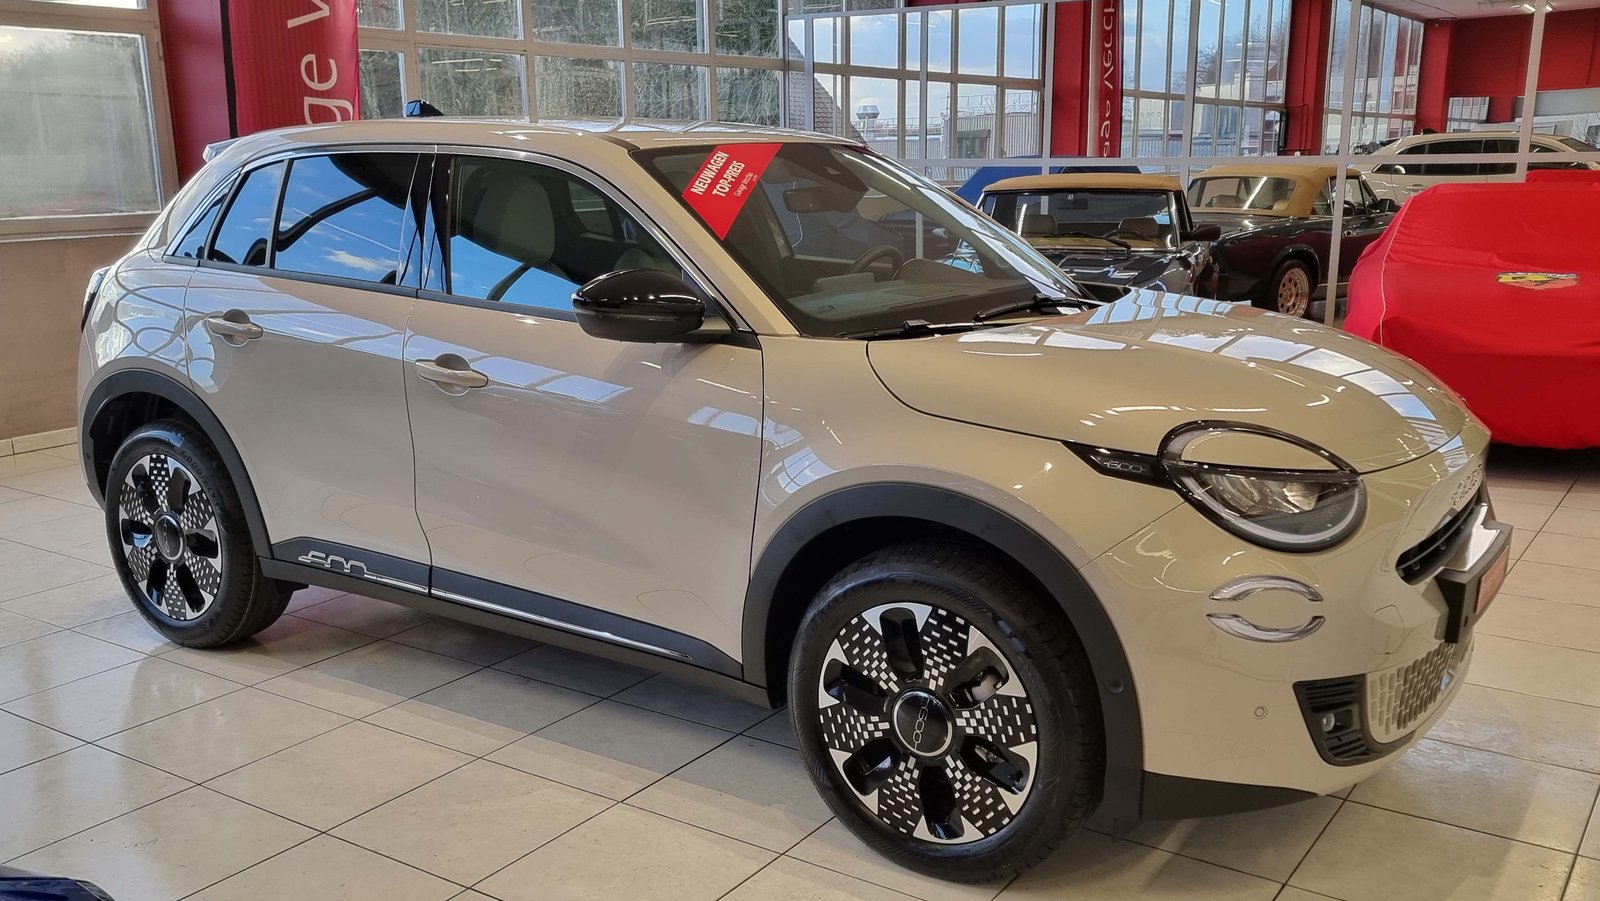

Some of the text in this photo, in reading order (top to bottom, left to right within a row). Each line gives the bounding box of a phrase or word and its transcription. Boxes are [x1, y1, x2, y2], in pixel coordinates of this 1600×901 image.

[690, 150, 730, 196] NEUWAGEN
[711, 160, 746, 198] TOP-PREIS
[1104, 460, 1146, 473] 600
